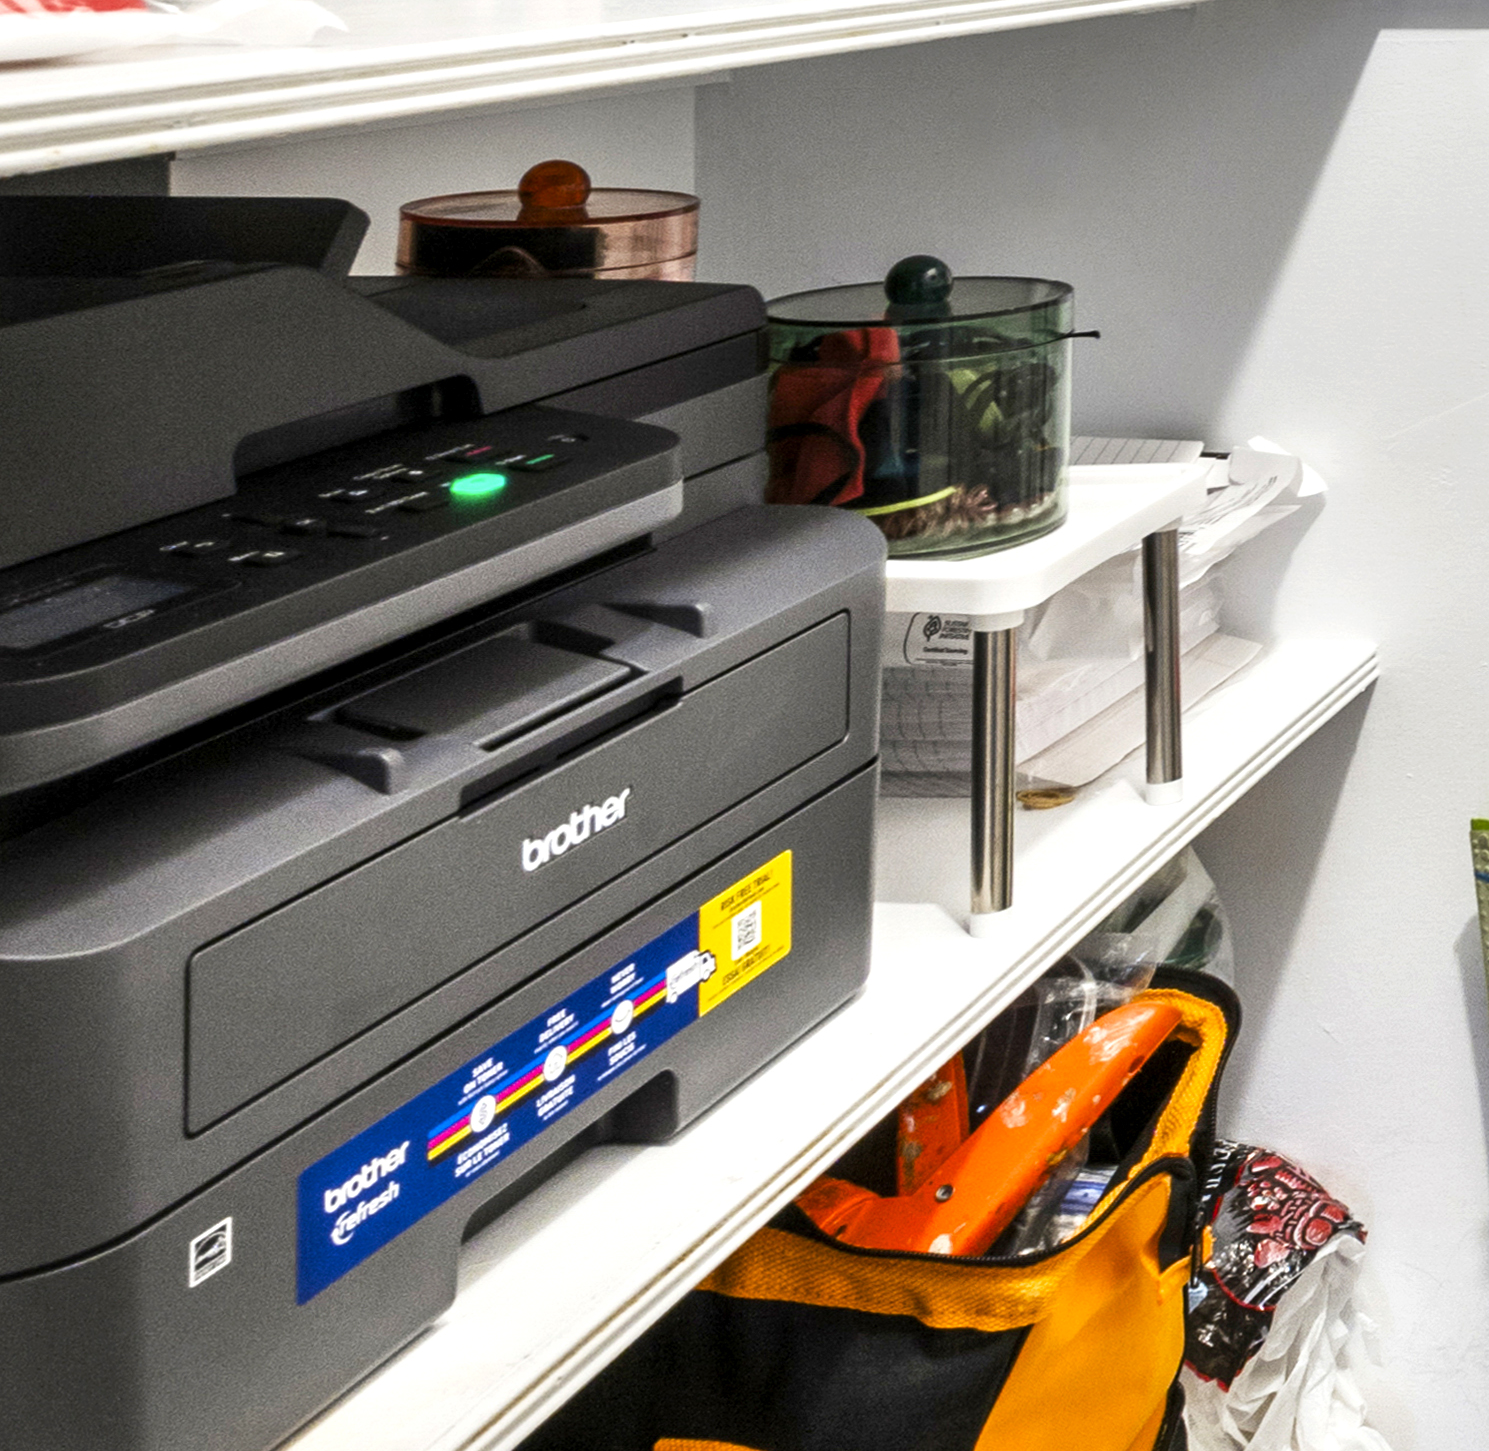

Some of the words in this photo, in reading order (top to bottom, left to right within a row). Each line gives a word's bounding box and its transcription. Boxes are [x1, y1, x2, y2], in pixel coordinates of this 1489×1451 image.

[520, 787, 632, 873] brother
[720, 895, 736, 911] RISK
[736, 885, 752, 901] FREE
[610, 972, 637, 995] WORRY
[611, 963, 636, 984] NEVER
[722, 967, 740, 986] ESSAI
[538, 1013, 575, 1043] DELIVERY
[547, 1008, 567, 1028] FREE
[463, 1080, 476, 1095] ON
[476, 1061, 504, 1088] TONER
[472, 1057, 494, 1078] SAVE
[536, 1074, 576, 1108] LIVRAISON
[537, 1085, 574, 1118] GRATUITE
[455, 1158, 474, 1178] SUR
[473, 1152, 483, 1167] LE
[482, 1132, 510, 1160] TONER
[324, 1140, 410, 1214] brother
[331, 1181, 400, 1245] refresh
